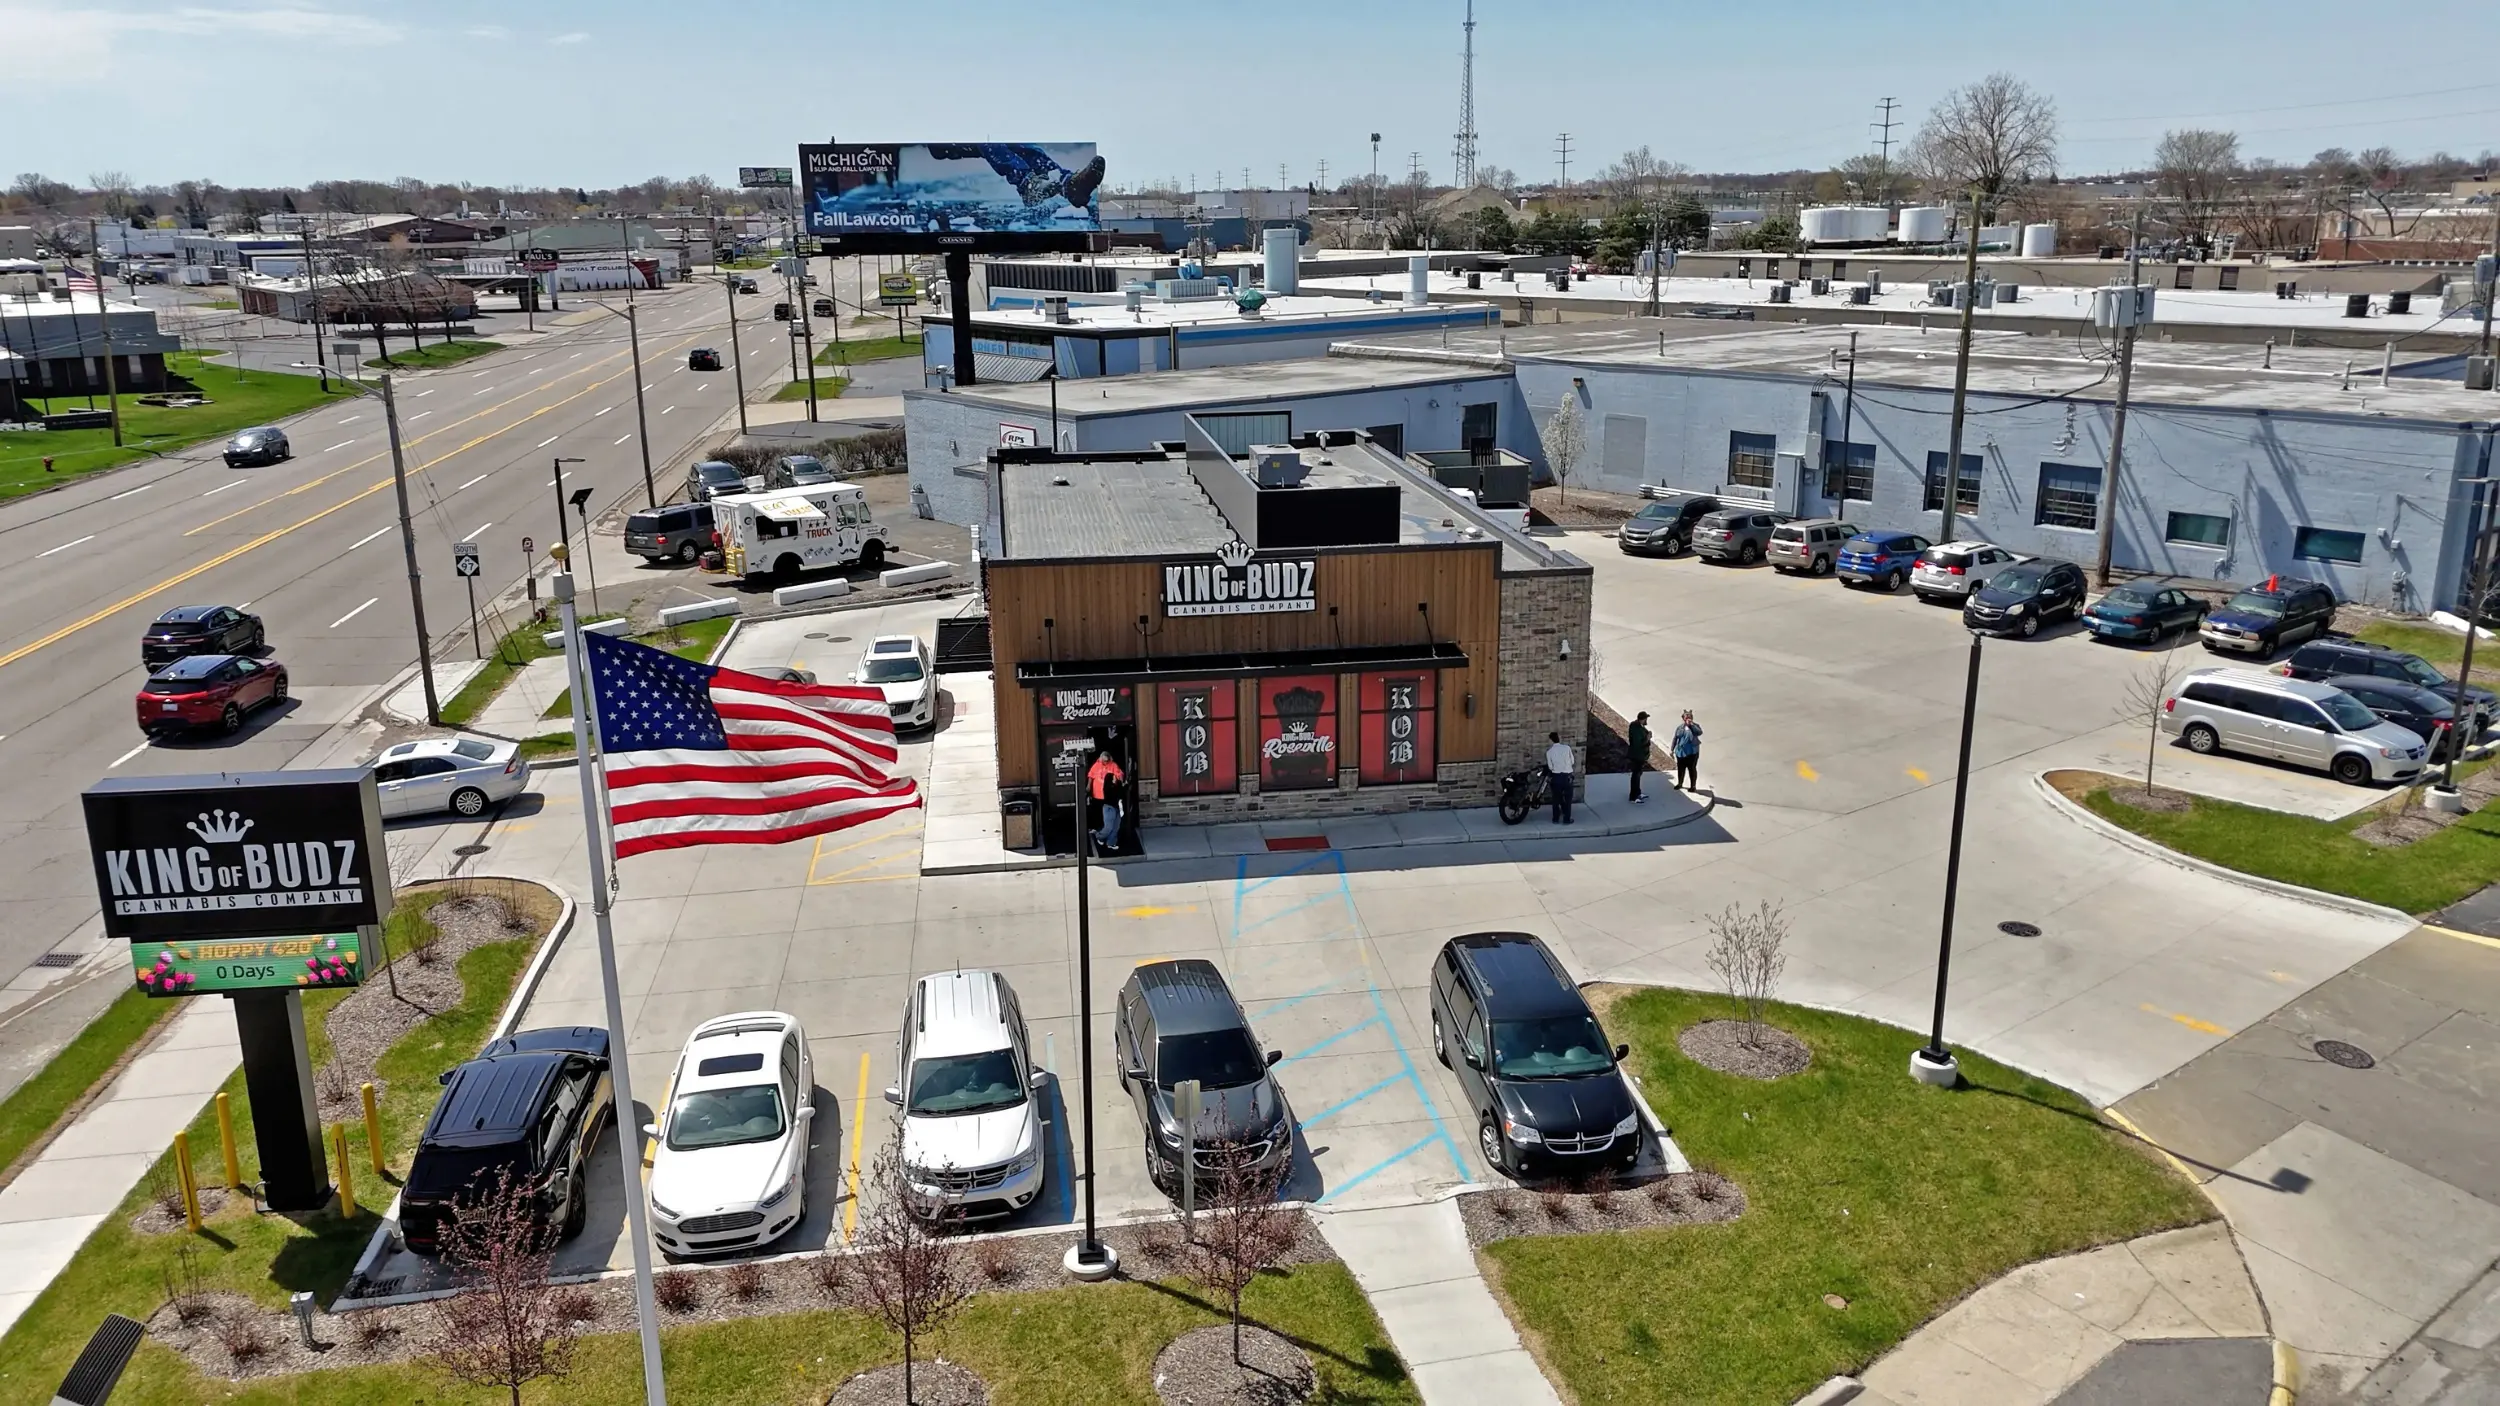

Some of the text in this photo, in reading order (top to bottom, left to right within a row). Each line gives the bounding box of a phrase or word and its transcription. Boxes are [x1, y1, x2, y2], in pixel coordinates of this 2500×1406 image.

[808, 150, 893, 171] MICHIGAN
[813, 212, 916, 227] FallLaw.com
[1008, 434, 1025, 444] RPS
[805, 527, 833, 539] TRUCK
[455, 545, 477, 553] SOUTH
[461, 562, 474, 571] 97
[1165, 561, 1315, 603] KING OF BUDZ
[1173, 601, 1311, 615] CANNABIS COMPANY
[1056, 690, 1083, 707] KING
[1087, 688, 1116, 706] BUDZ
[1062, 703, 1112, 720] Roseville
[1390, 686, 1413, 765] KOB
[1183, 697, 1209, 775] KOB
[1262, 735, 1336, 759] Roseville
[105, 840, 361, 896] KING OF BUDZ
[122, 889, 356, 913] CANNABIS COMPANY
[197, 940, 314, 961] HOPPY 420
[216, 965, 276, 979] 0 Days
